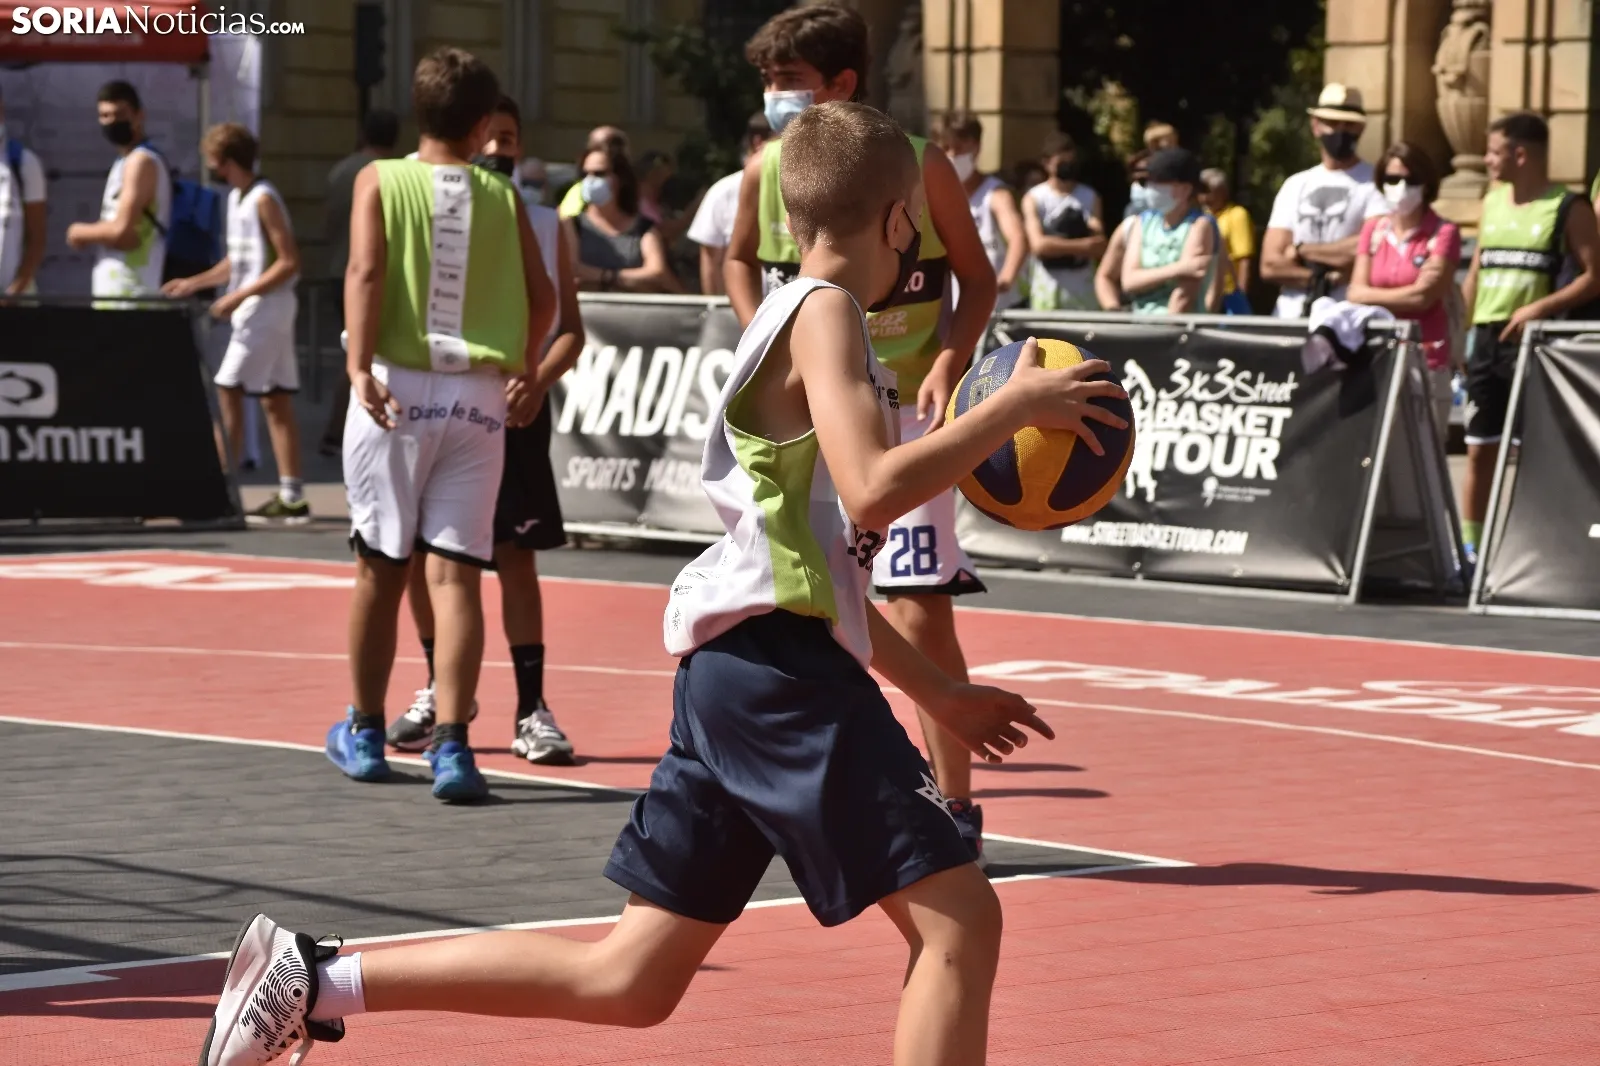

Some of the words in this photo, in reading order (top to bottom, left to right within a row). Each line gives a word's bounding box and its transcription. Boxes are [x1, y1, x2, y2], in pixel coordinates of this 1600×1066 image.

[1153, 399, 1293, 438] BASKET
[16, 424, 144, 463] SMITH
[1152, 430, 1282, 481] TOUR
[562, 456, 641, 491] SPORTS
[890, 525, 938, 577] 28
